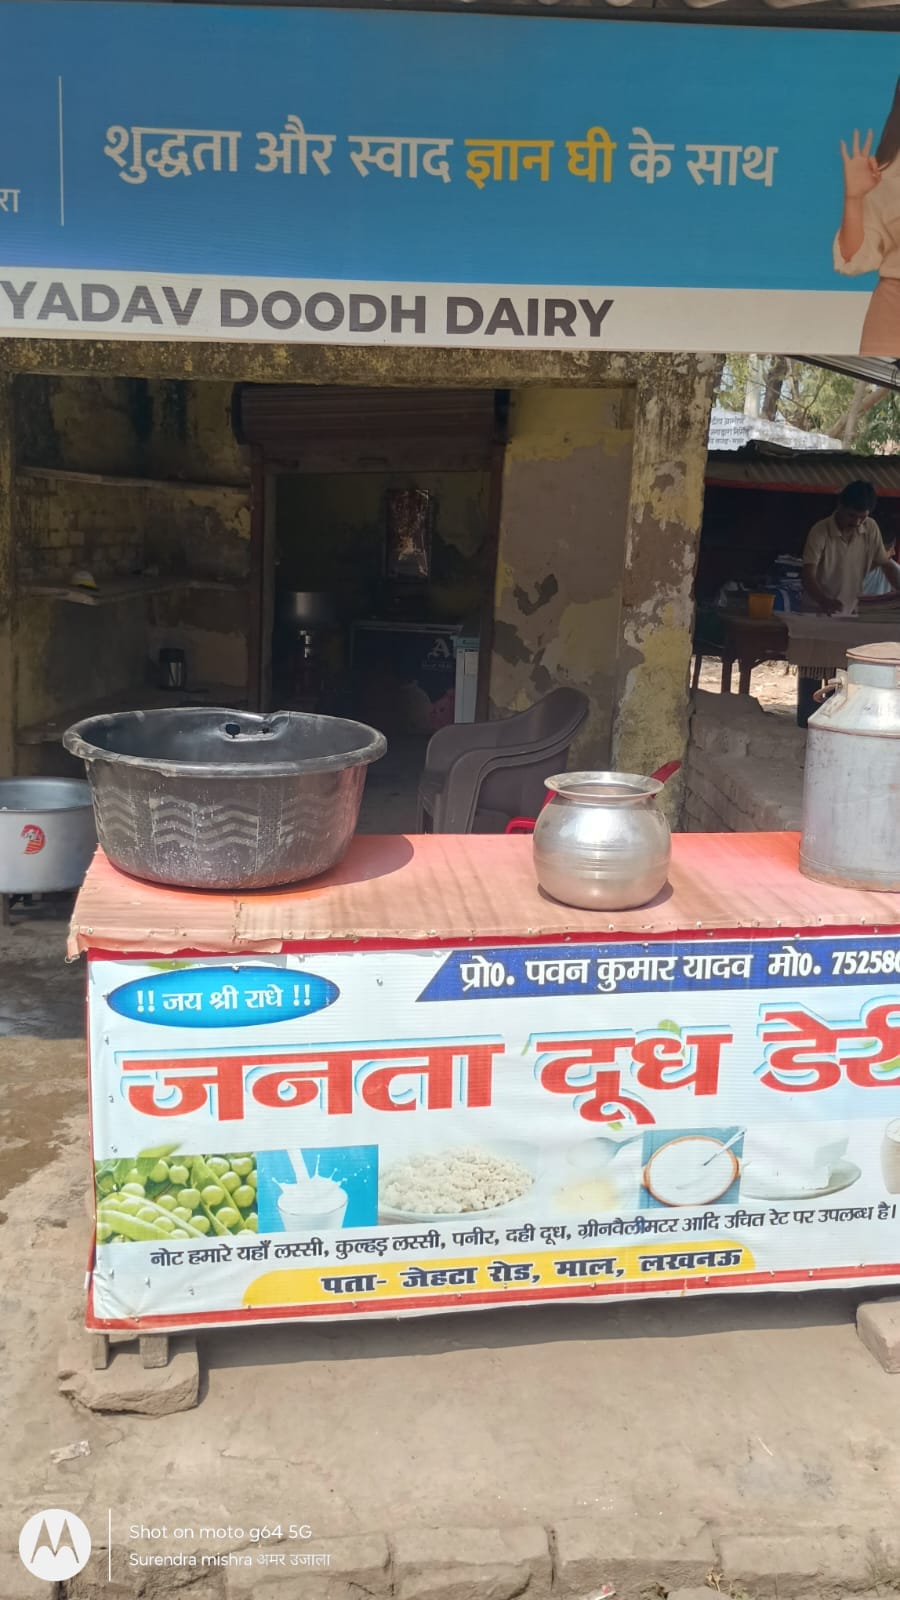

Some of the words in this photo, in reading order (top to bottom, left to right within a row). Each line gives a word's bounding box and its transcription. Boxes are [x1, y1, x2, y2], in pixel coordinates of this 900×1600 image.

[104, 125, 242, 184] शुद्धता
[255, 115, 336, 175] और
[348, 135, 454, 183] स्वाद
[464, 138, 554, 190] ज्ञान
[565, 126, 617, 183] घी
[628, 127, 675, 184] के
[686, 143, 778, 187] साथ
[0, 280, 203, 326] YADAV
[220, 288, 426, 334] DOODH
[446, 296, 614, 337] DAIRY
[162, 991, 203, 1012] जय
[208, 983, 239, 1010] श्री
[244, 984, 284, 1009] राधे
[525, 958, 590, 986] पवन
[597, 956, 678, 991] कुमार
[683, 954, 753, 980] यादव
[122, 1043, 505, 1122] जनता
[536, 1033, 733, 1125] दूध
[150, 1248, 184, 1267] नोट
[188, 1244, 232, 1265] हमारे
[274, 1237, 329, 1258] लस्सी,
[336, 1237, 389, 1260] कुल्हड़
[392, 1229, 446, 1250] लस्सी,
[452, 1226, 500, 1247] पनीर,
[506, 1223, 536, 1243] दही
[540, 1225, 571, 1246] दूध,
[682, 1211, 720, 1232] आदि
[724, 1209, 766, 1229] उचित
[769, 1208, 790, 1226] रेट
[793, 1209, 815, 1224] पर
[818, 1206, 874, 1223] उपलब्ध
[400, 1267, 478, 1288] जेहटा
[487, 1260, 540, 1284] रोड,
[554, 1257, 625, 1278] माल,
[638, 1248, 743, 1273] लखनऊ
